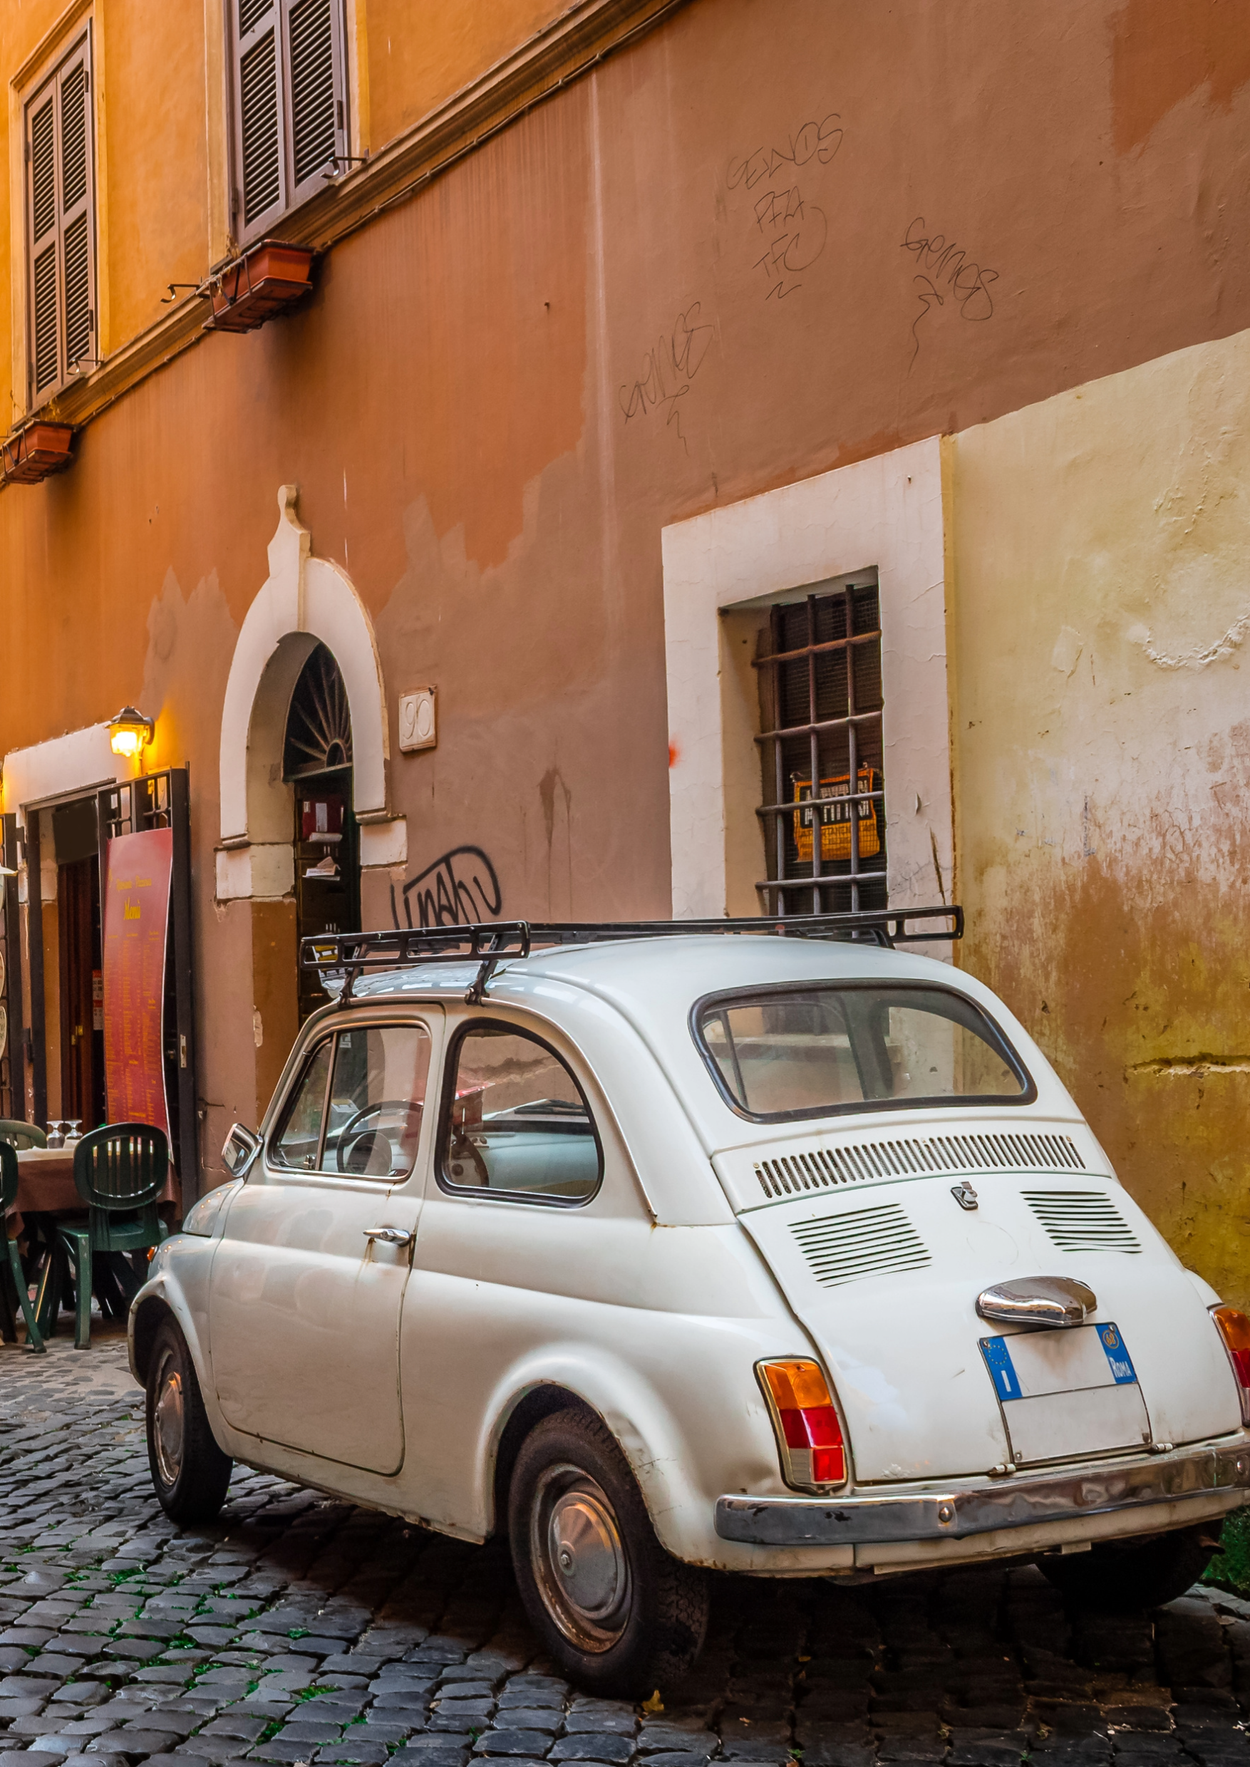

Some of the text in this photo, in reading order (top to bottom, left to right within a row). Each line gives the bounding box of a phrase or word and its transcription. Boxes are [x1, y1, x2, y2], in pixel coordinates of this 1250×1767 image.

[402, 698, 432, 740] 90
[1109, 1356, 1133, 1378] ROMA
[1001, 1370, 1011, 1392] I
